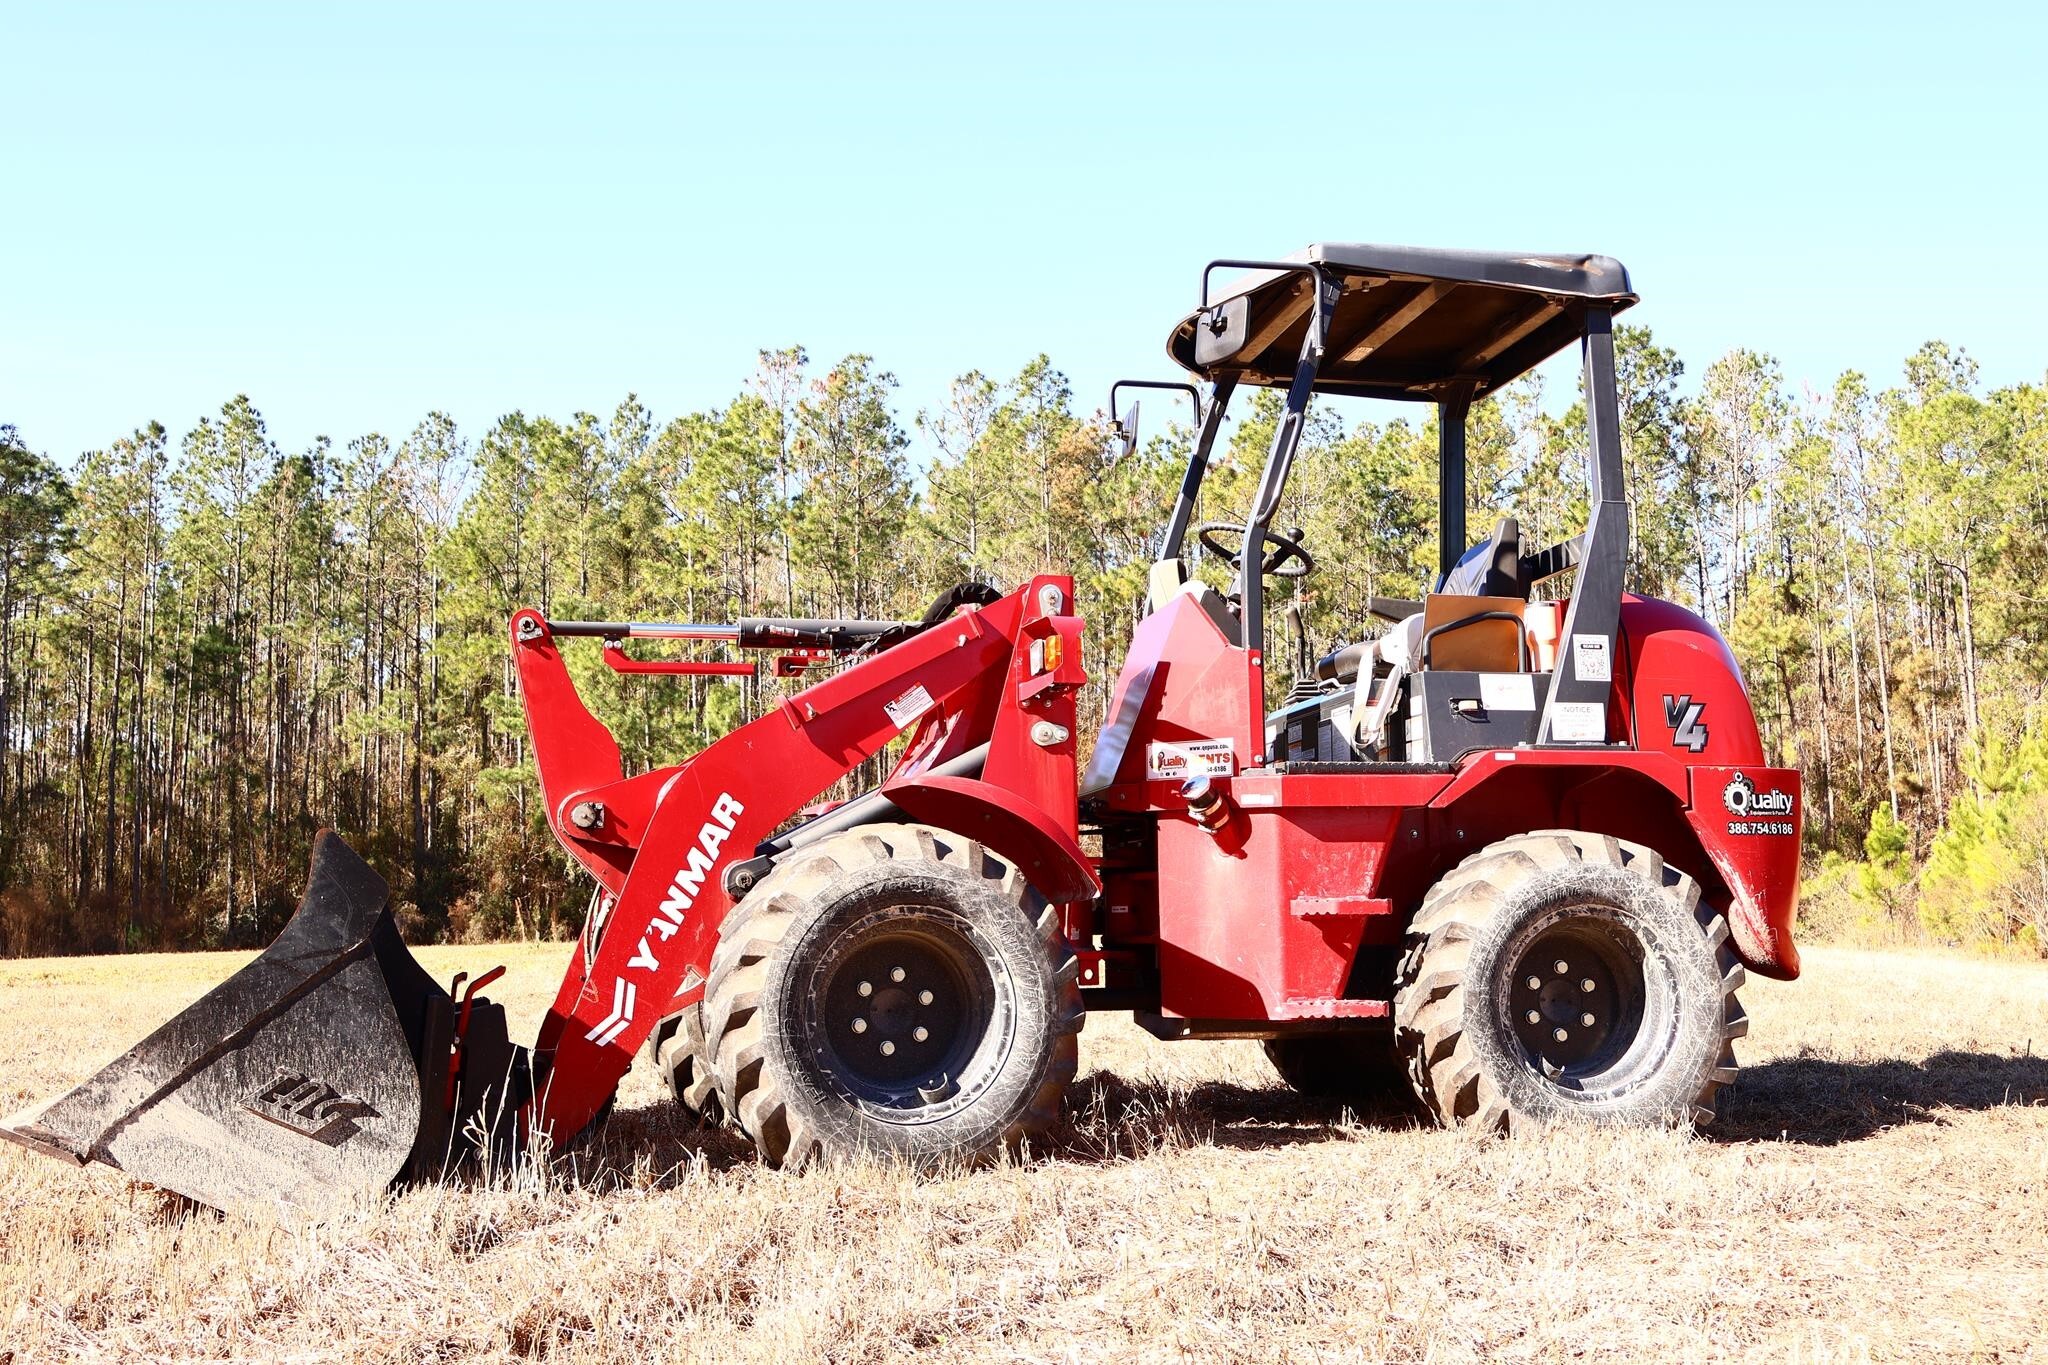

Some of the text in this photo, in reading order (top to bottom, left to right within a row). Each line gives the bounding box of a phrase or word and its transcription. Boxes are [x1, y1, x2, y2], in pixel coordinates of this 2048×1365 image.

[1663, 694, 1709, 753] V4
[1724, 782, 1793, 817] Quality
[1728, 822, 1793, 835] 386.754.6186
[626, 791, 745, 972] YANMAR
